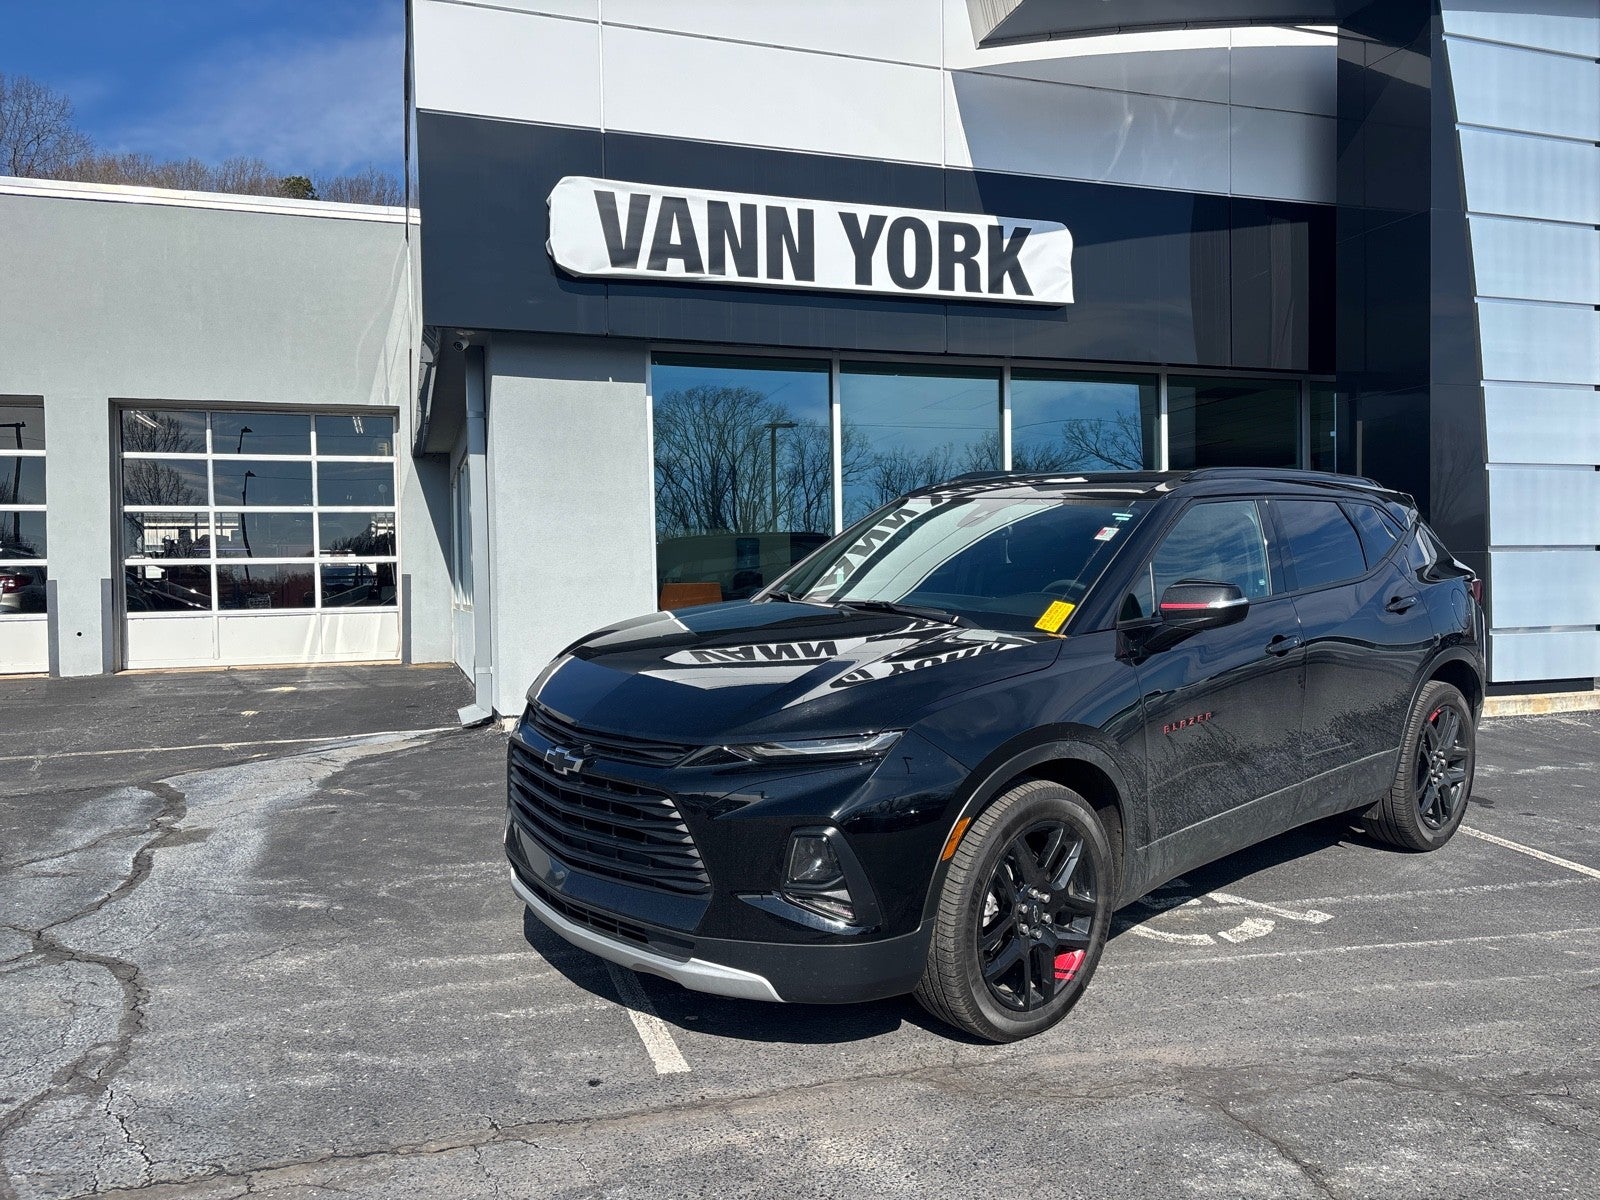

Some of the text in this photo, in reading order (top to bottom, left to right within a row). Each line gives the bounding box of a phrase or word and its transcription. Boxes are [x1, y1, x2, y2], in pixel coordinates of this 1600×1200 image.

[594, 190, 1034, 296] VANN YORK
[1163, 712, 1212, 735] BLAZER
